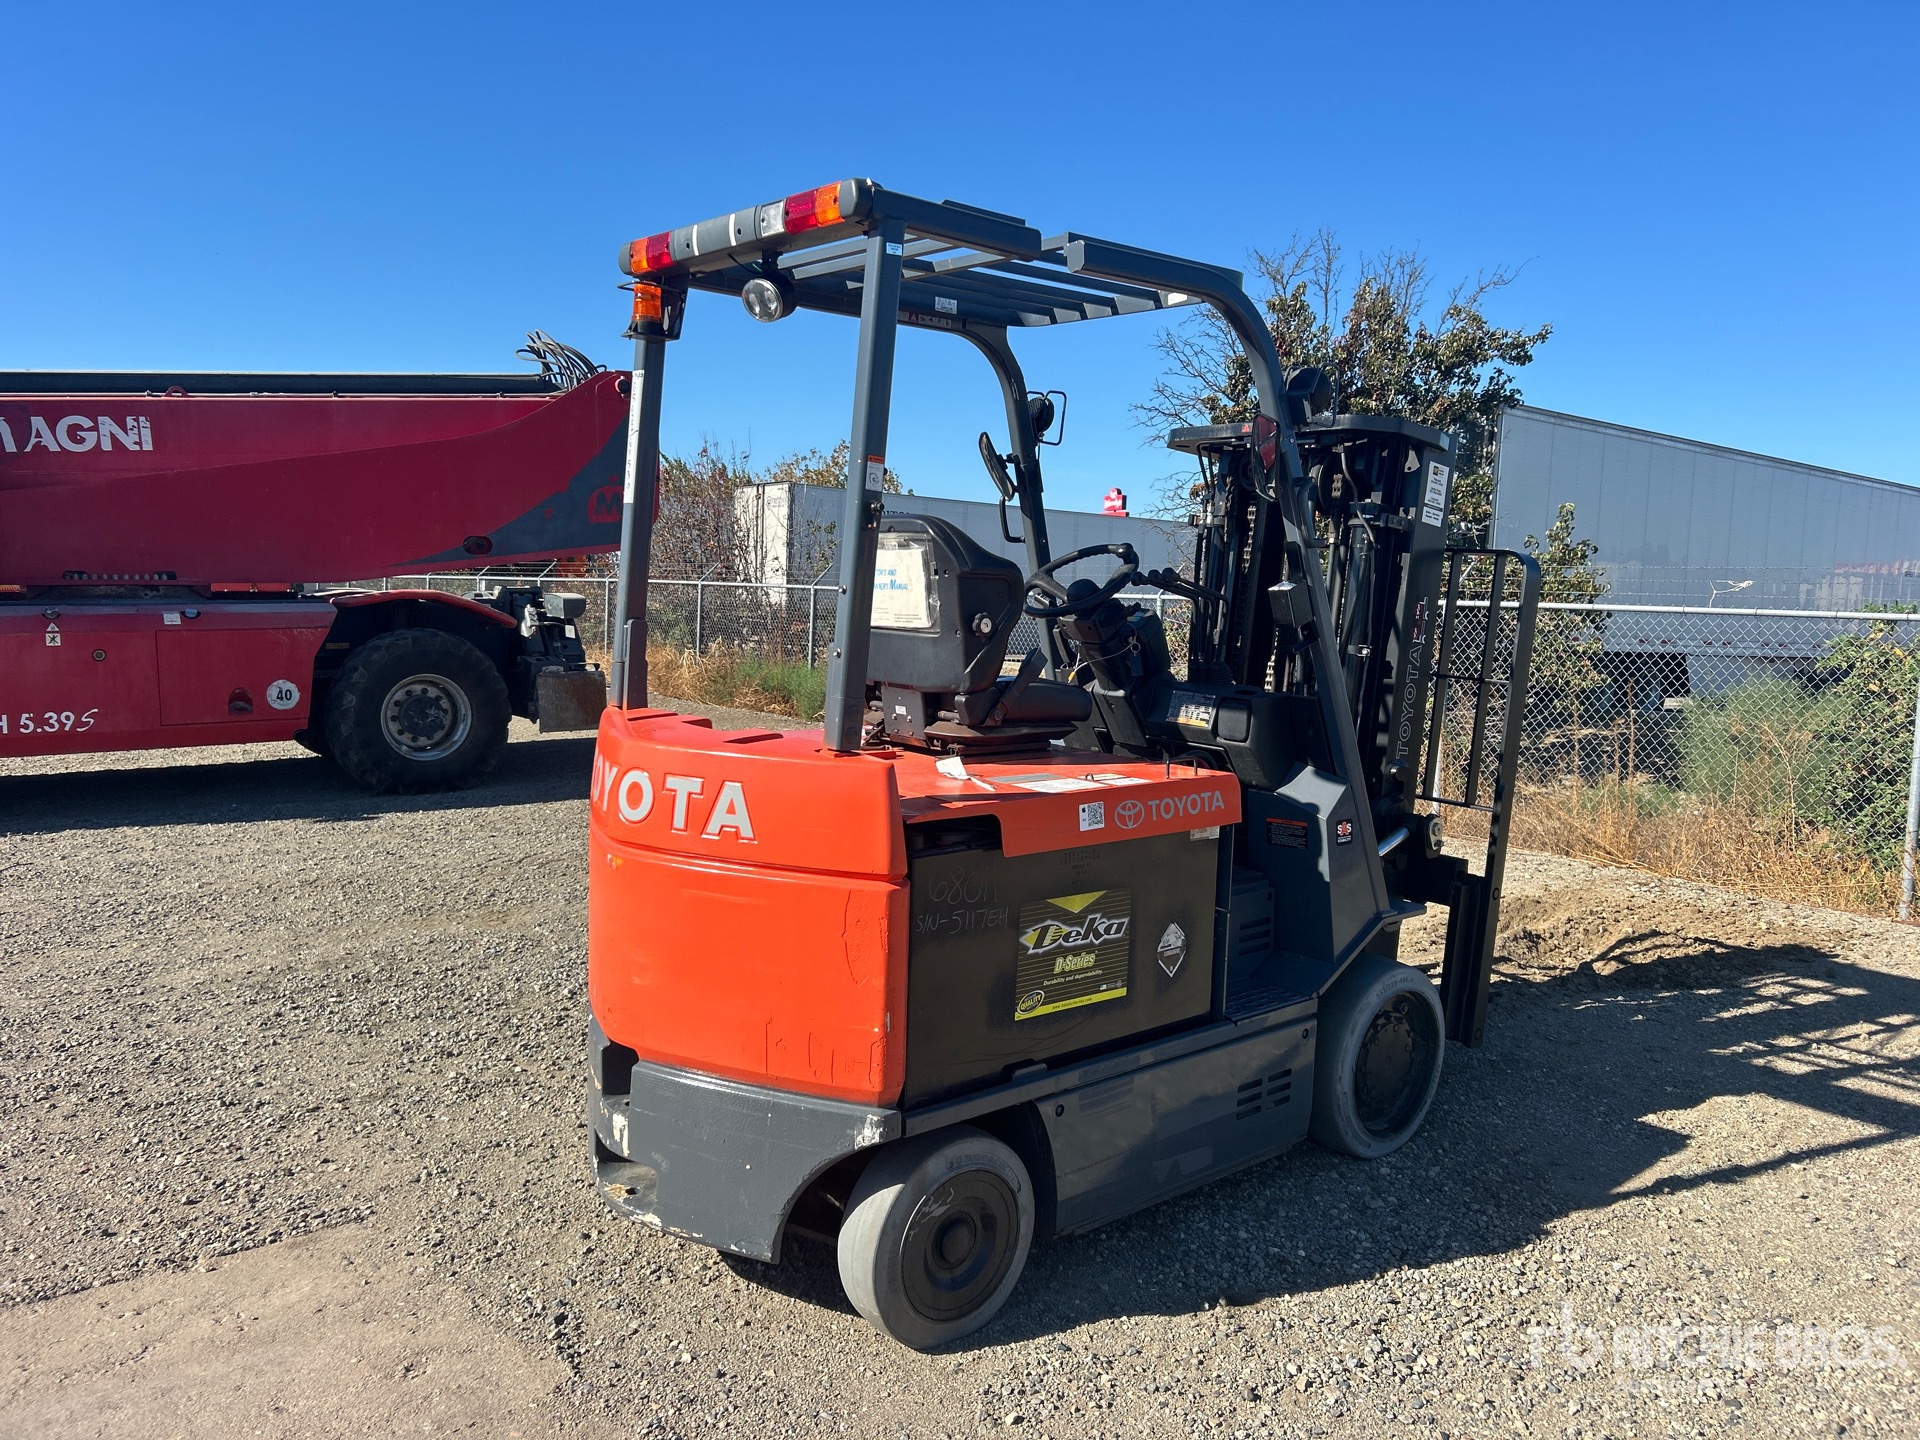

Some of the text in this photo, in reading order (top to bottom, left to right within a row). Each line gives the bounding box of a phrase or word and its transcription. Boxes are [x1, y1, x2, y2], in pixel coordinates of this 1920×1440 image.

[276, 688, 293, 702] 40
[1396, 645, 1422, 760] TOYOTA
[592, 755, 757, 843] OYOTA
[1148, 790, 1225, 821] TOYOTA
[1028, 914, 1129, 953] Deka
[1053, 952, 1096, 974] D-Series
[1020, 994, 1042, 1010] QUALITY
